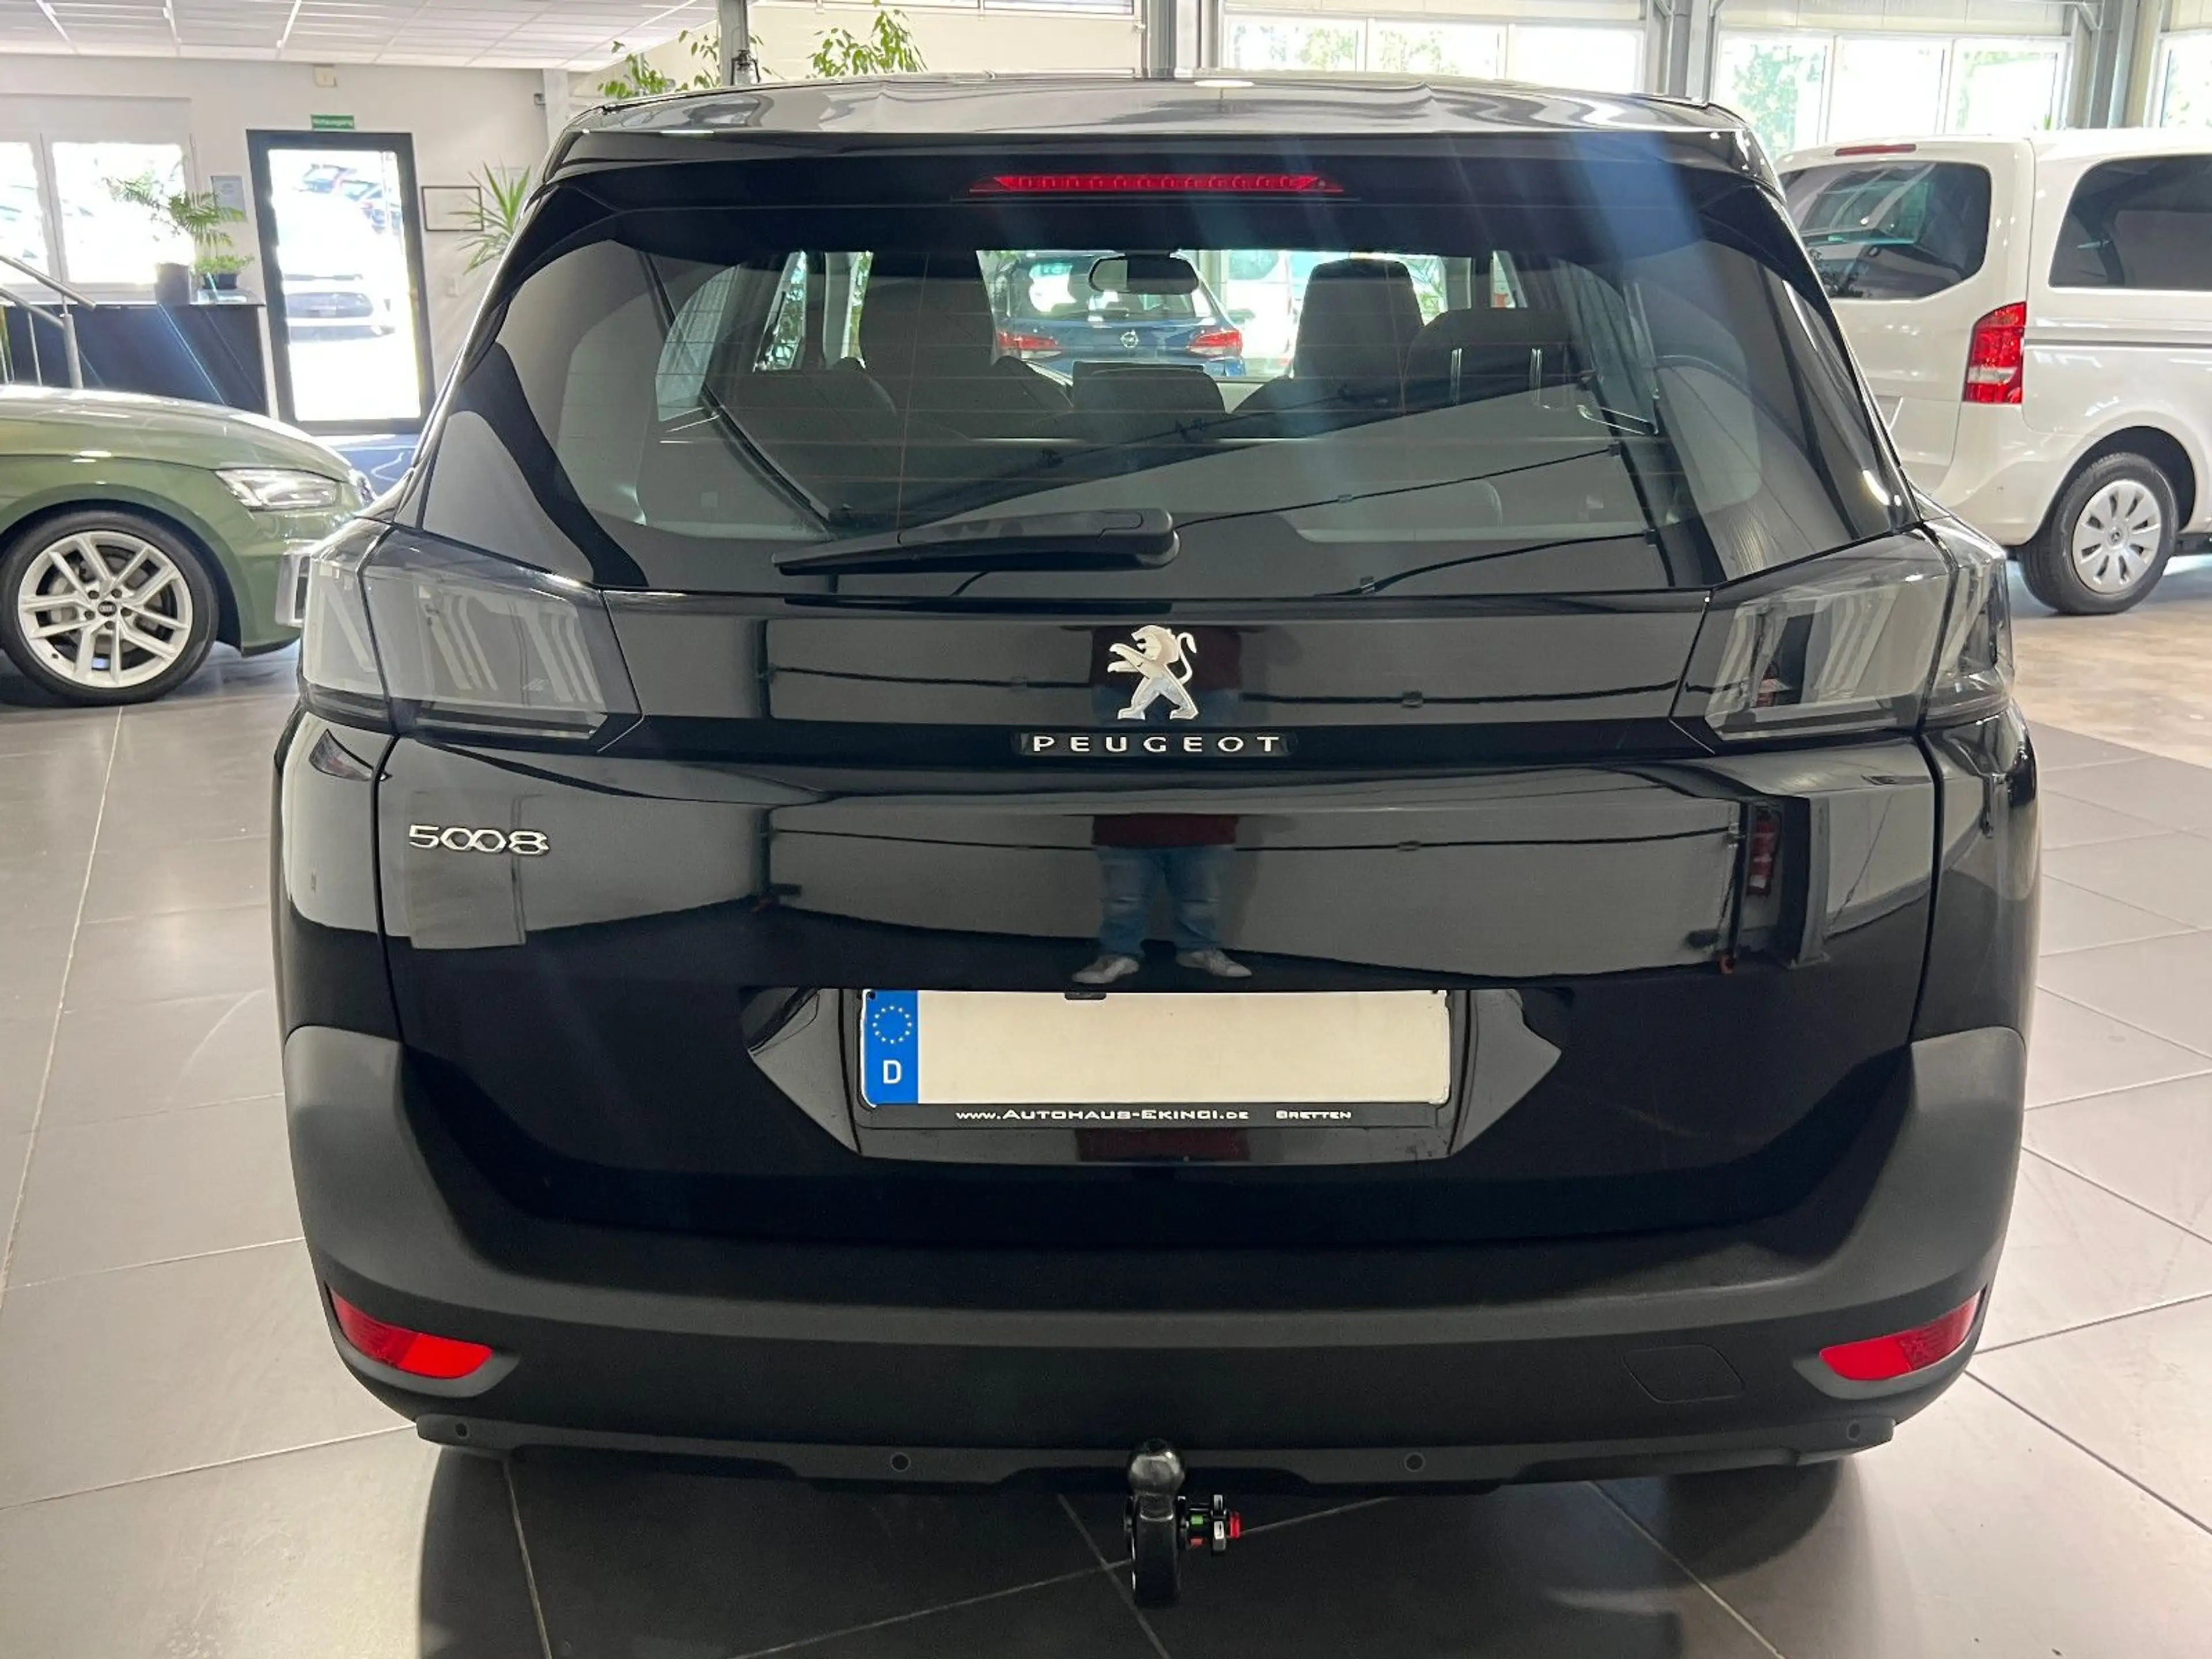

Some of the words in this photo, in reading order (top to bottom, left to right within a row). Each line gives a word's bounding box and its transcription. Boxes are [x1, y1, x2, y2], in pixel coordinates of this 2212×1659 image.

[1033, 736, 1279, 752] PEUGEOT
[409, 824, 550, 855] 5008
[882, 1059, 902, 1084] D
